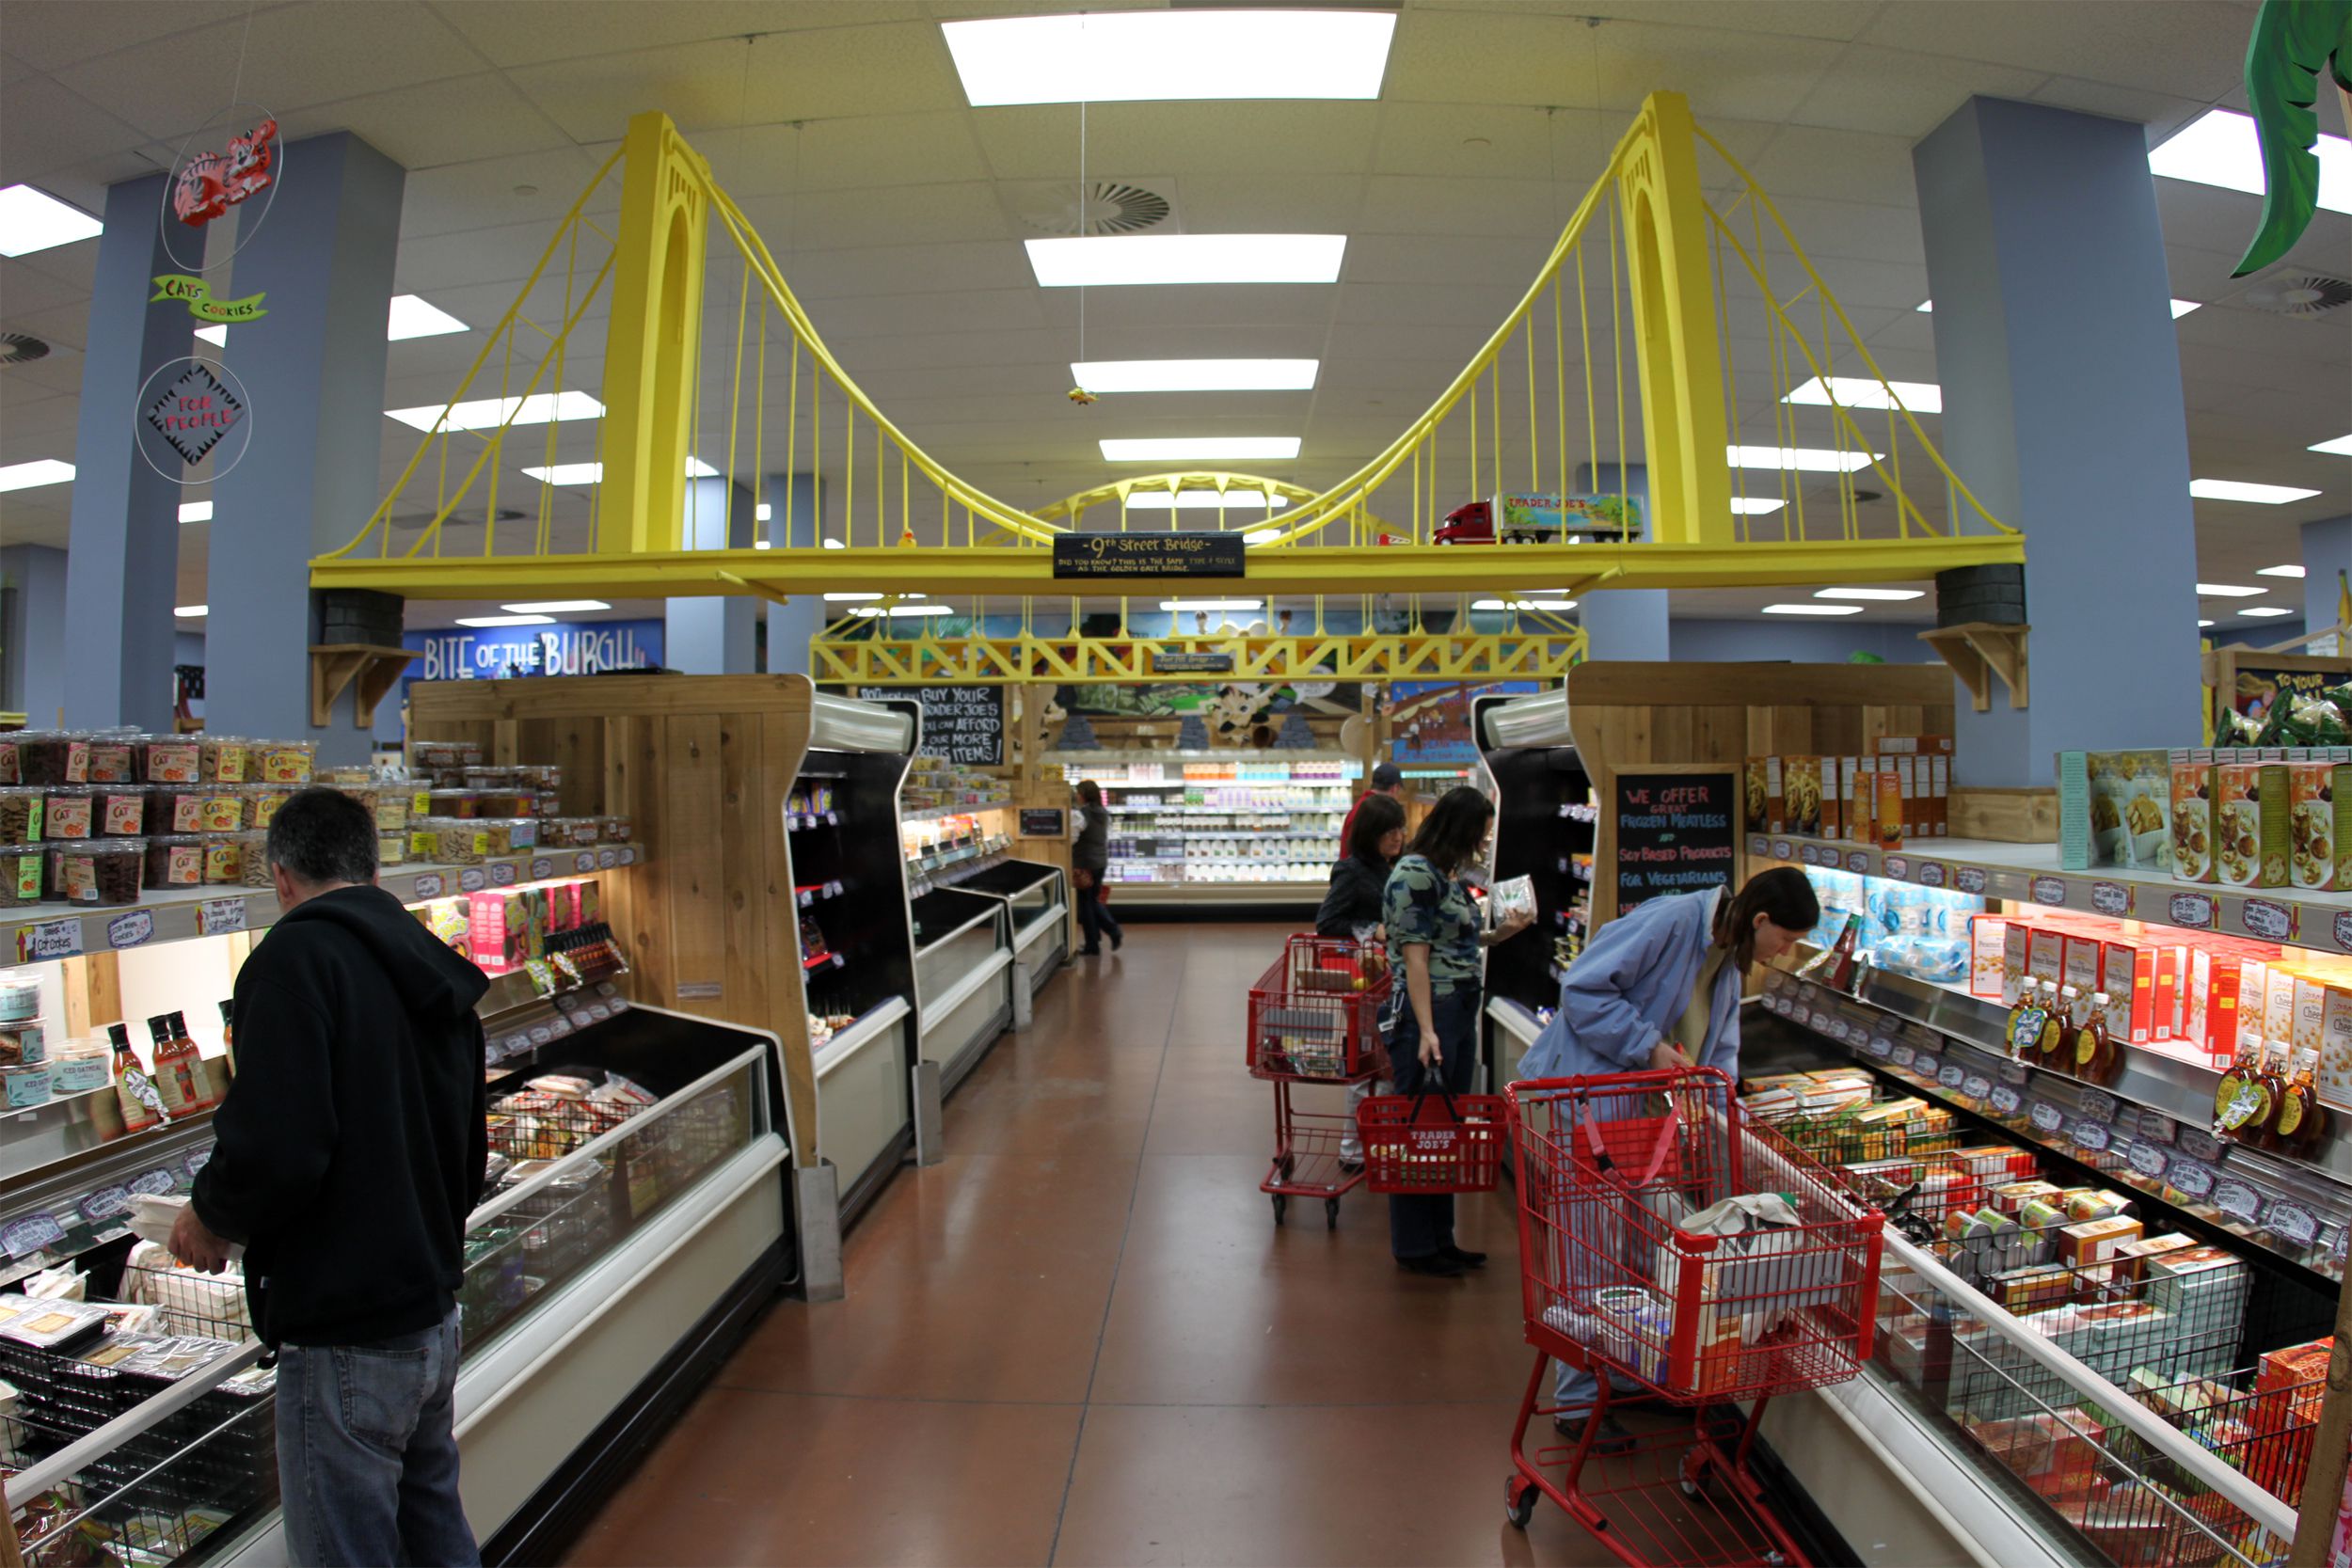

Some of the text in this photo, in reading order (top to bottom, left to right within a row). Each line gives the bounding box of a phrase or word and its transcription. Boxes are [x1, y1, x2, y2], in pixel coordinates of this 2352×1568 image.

[166, 280, 203, 299] CATS
[201, 303, 254, 317] COOKIES
[179, 396, 212, 412] FOR
[166, 409, 234, 431] PEOPLE
[1509, 498, 1550, 508] TRADER
[1118, 538, 1160, 551] Street
[423, 636, 475, 681] BITE
[475, 643, 500, 669] OF
[500, 641, 541, 666] THE
[2276, 673, 2325, 691] TO YOUR
[922, 688, 948, 703] BUY
[952, 688, 990, 703] YOUR
[923, 705, 961, 717] RADER
[923, 721, 936, 732] OU
[956, 718, 1001, 733] AFFORD
[952, 733, 992, 745] MORE
[1626, 785, 1710, 804] WE OFFER
[1650, 803, 1689, 815] GREAT
[1620, 812, 1727, 829] FROZEN MEATLESS
[1619, 845, 1732, 863] SOY BASED PRODUCTS
[1620, 870, 1728, 888] FOR VEGETARIANS
[2274, 993, 2293, 1008] Chee
[2303, 1006, 2322, 1021] Chee
[1411, 1131, 1457, 1140] TRADER
[1416, 1140, 1450, 1149] JOE'S
